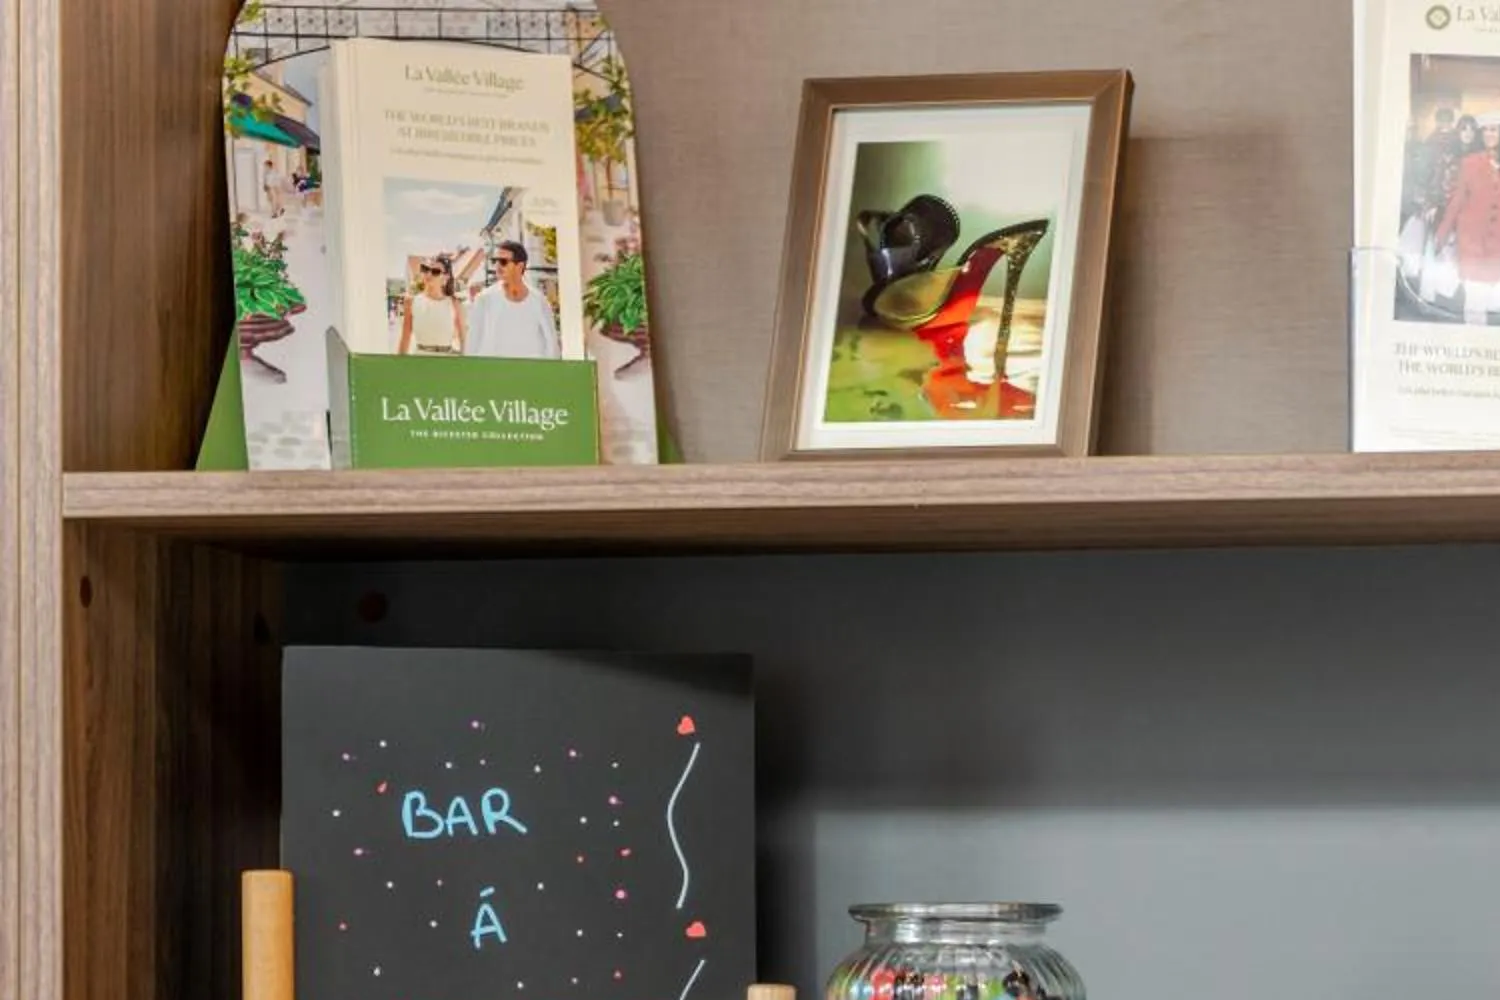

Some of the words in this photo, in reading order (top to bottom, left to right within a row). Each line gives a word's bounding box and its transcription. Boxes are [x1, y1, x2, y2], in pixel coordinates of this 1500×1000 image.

[381, 397, 411, 421] La
[413, 397, 486, 422] Vallée
[488, 399, 570, 431] Village
[401, 787, 527, 839] BAR
